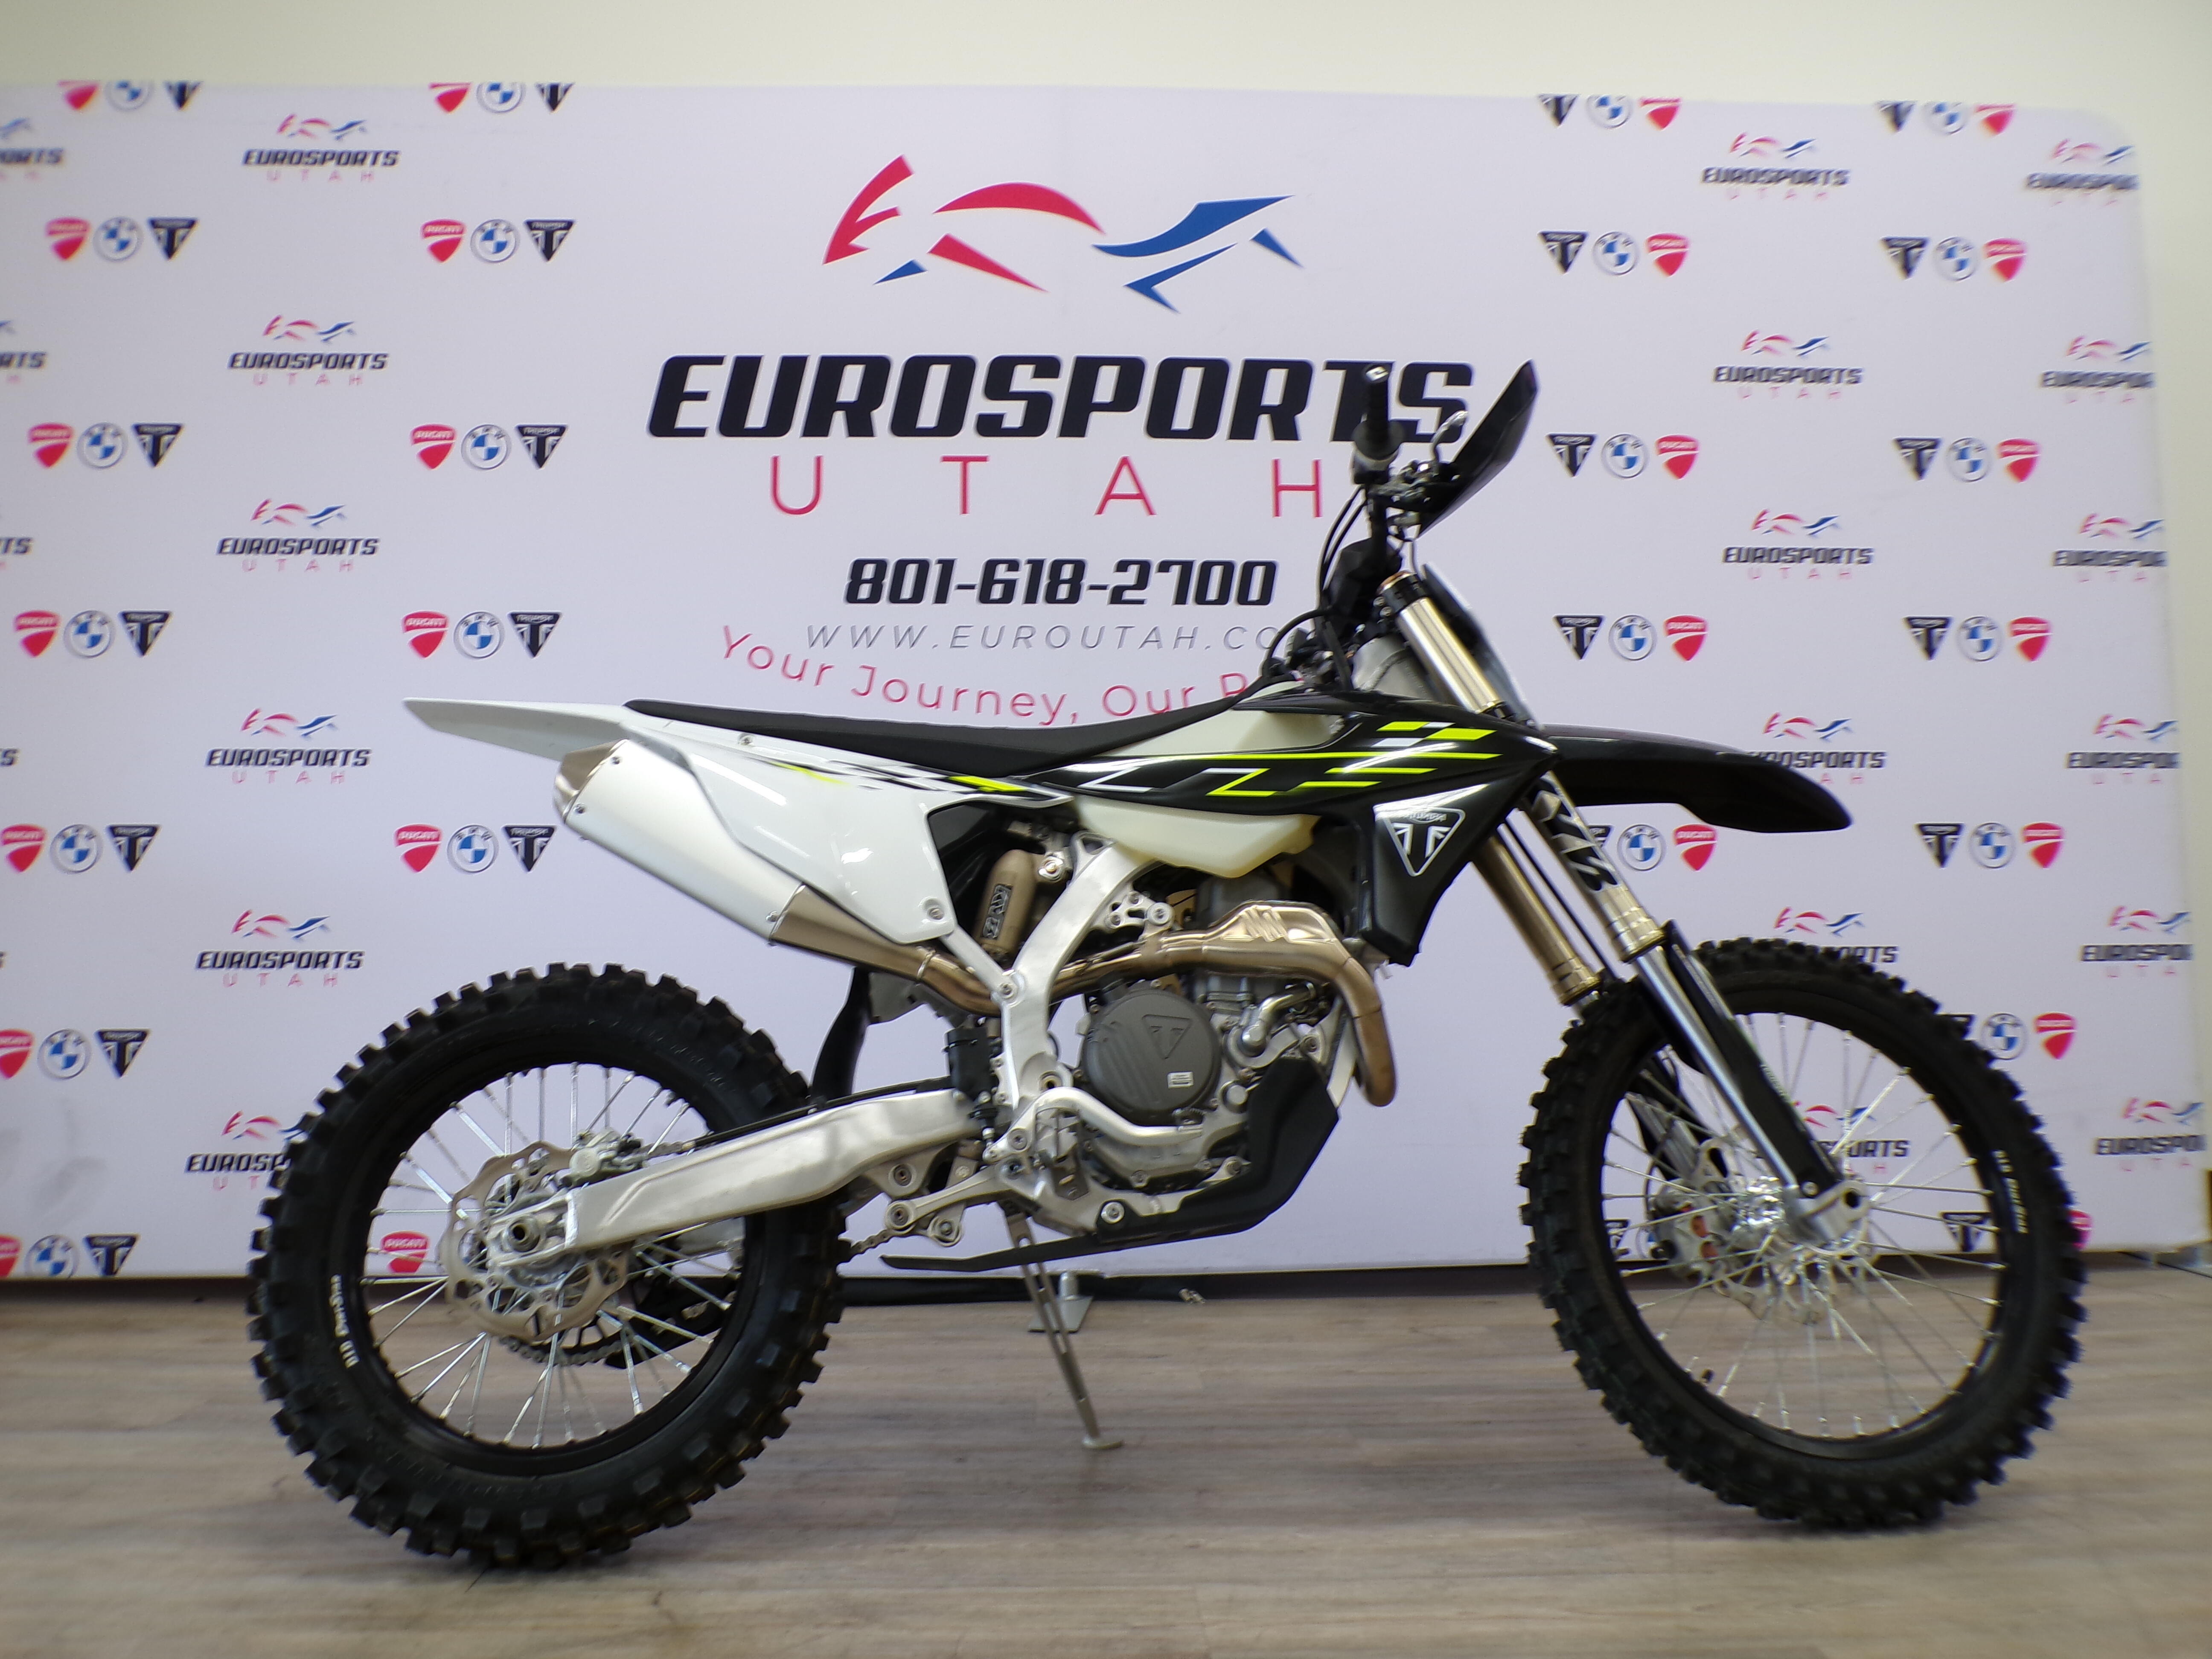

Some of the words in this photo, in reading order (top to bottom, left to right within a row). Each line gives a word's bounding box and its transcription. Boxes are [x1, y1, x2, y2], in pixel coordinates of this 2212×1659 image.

[243, 150, 400, 166] EUROSPORTS
[229, 353, 388, 369] EUROSPORTS
[647, 354, 1474, 444] EUROSPORTS
[771, 455, 1322, 518] UTAH
[216, 538, 379, 555] EUROSPORTS
[242, 559, 353, 572] UTAH
[844, 558, 1278, 605] 801-618-2700
[807, 624, 1280, 649] WWW.EUROUTAH.CO
[722, 625, 835, 687] Your
[851, 664, 1080, 726] Journey,
[1102, 684, 1195, 717] Our
[206, 749, 371, 766] EUROSPORTS
[231, 771, 345, 784] UTAH
[197, 952, 365, 969] EUROSPORTS
[223, 973, 338, 987] UTAH
[186, 1154, 288, 1171] EUROSP
[213, 1176, 259, 1190] UT
